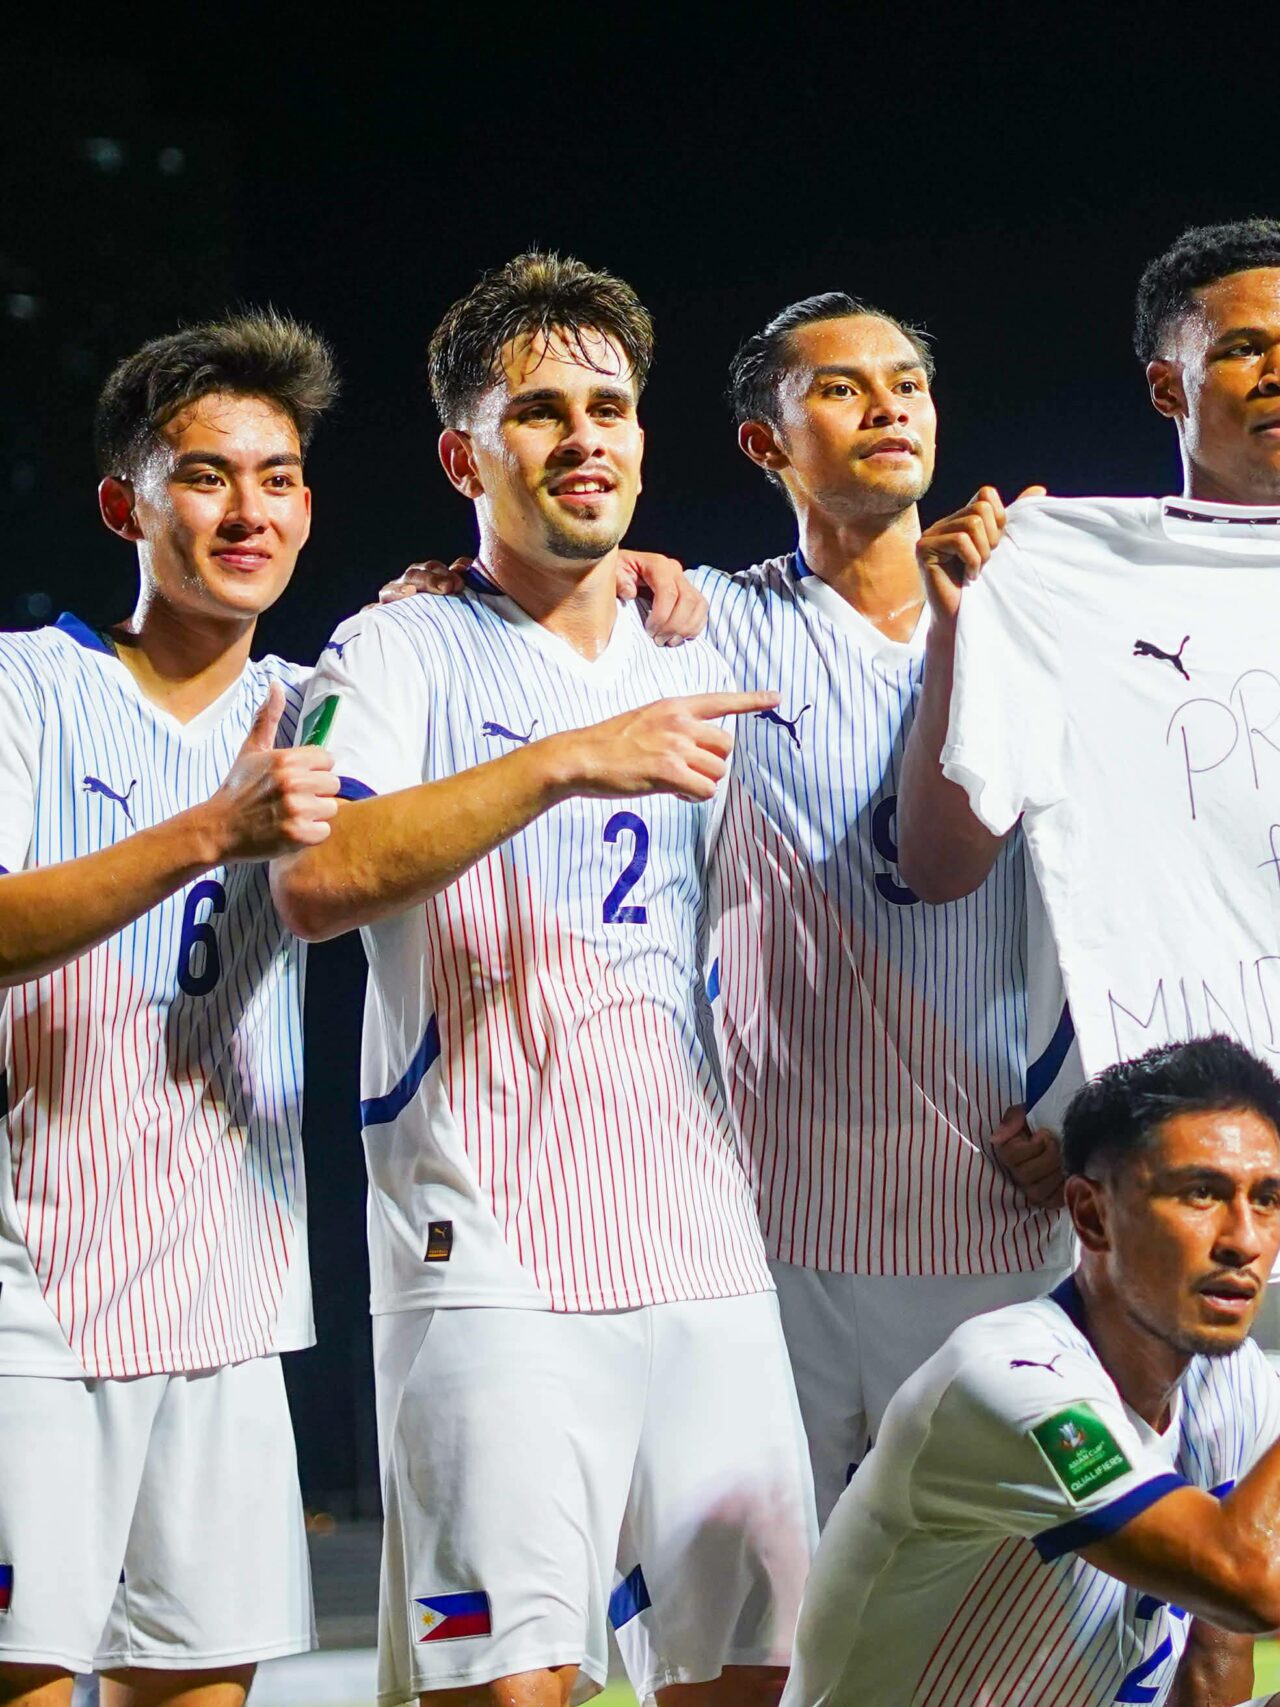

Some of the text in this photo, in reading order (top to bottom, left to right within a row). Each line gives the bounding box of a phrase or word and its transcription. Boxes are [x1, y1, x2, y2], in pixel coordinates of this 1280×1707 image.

[602, 811, 648, 924] 2
[177, 879, 225, 996] 6
[1070, 1454, 1123, 1491] QUALIFIERS
